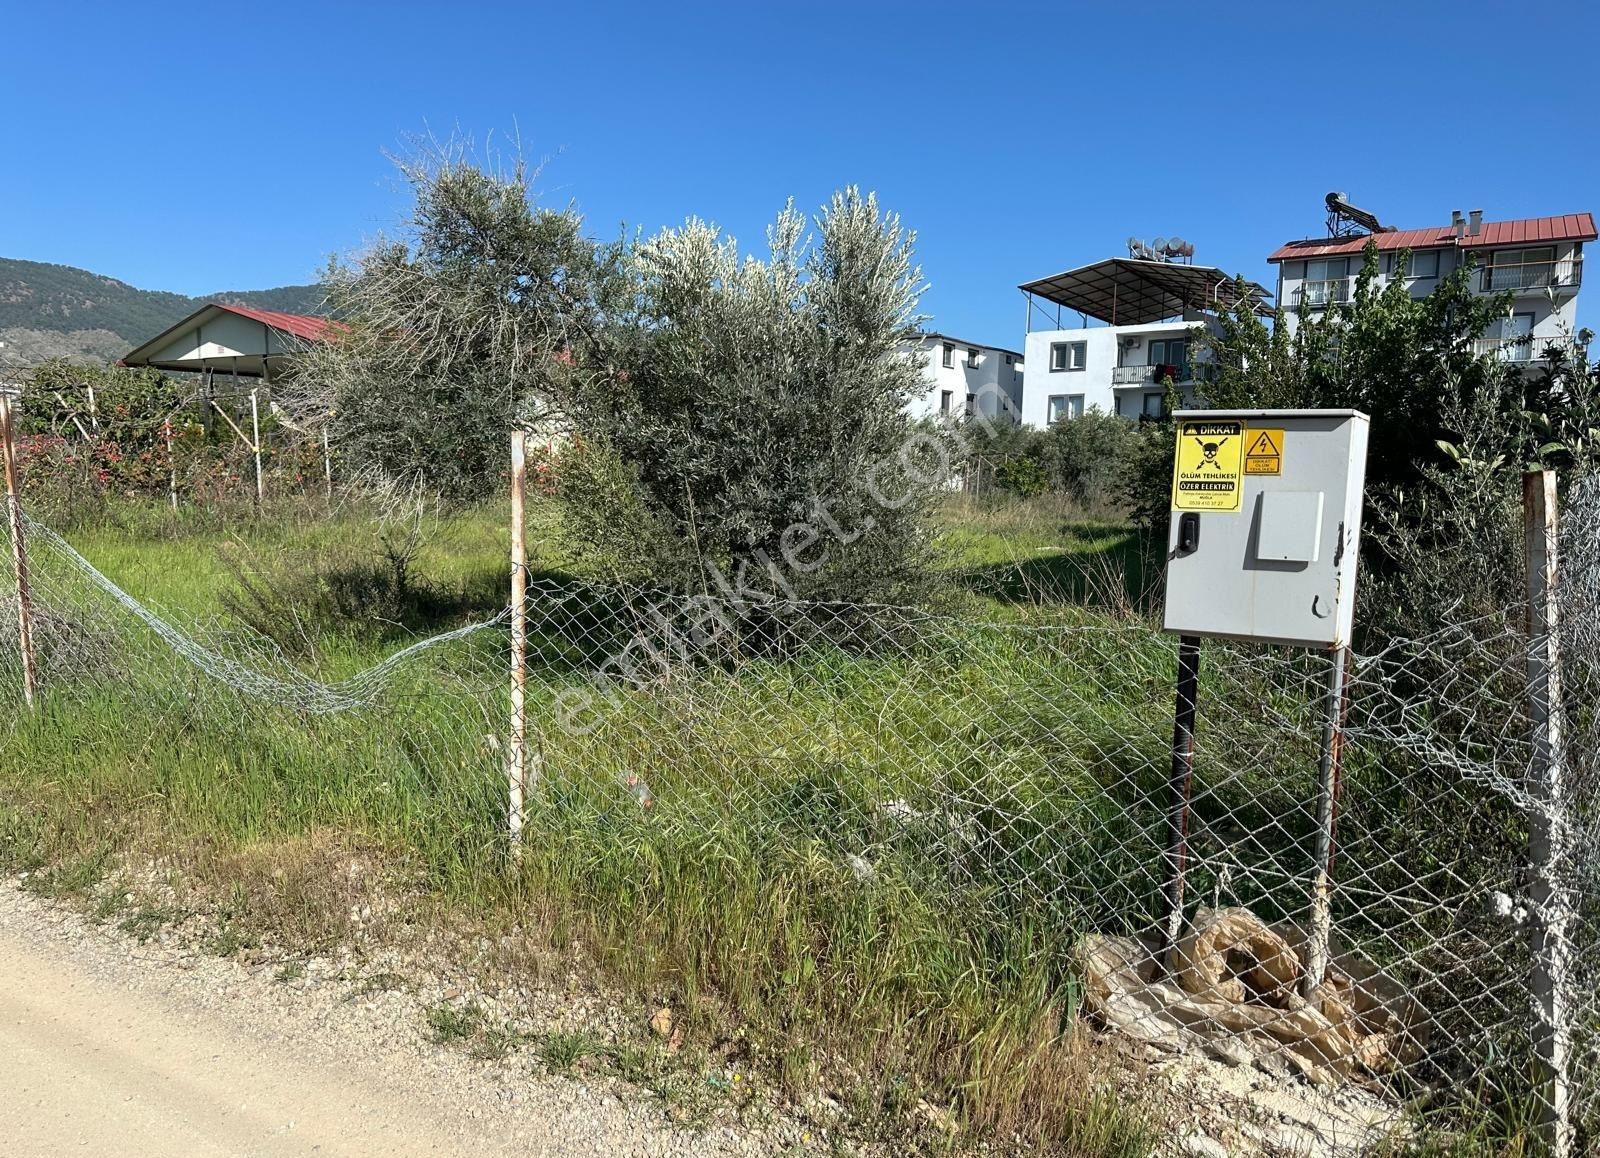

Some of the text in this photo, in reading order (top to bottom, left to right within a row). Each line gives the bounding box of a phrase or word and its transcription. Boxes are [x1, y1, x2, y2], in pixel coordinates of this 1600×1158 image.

[1200, 424, 1236, 435] DİKKAT
[1180, 482, 1234, 490] ÖZER ELEKTRİK
